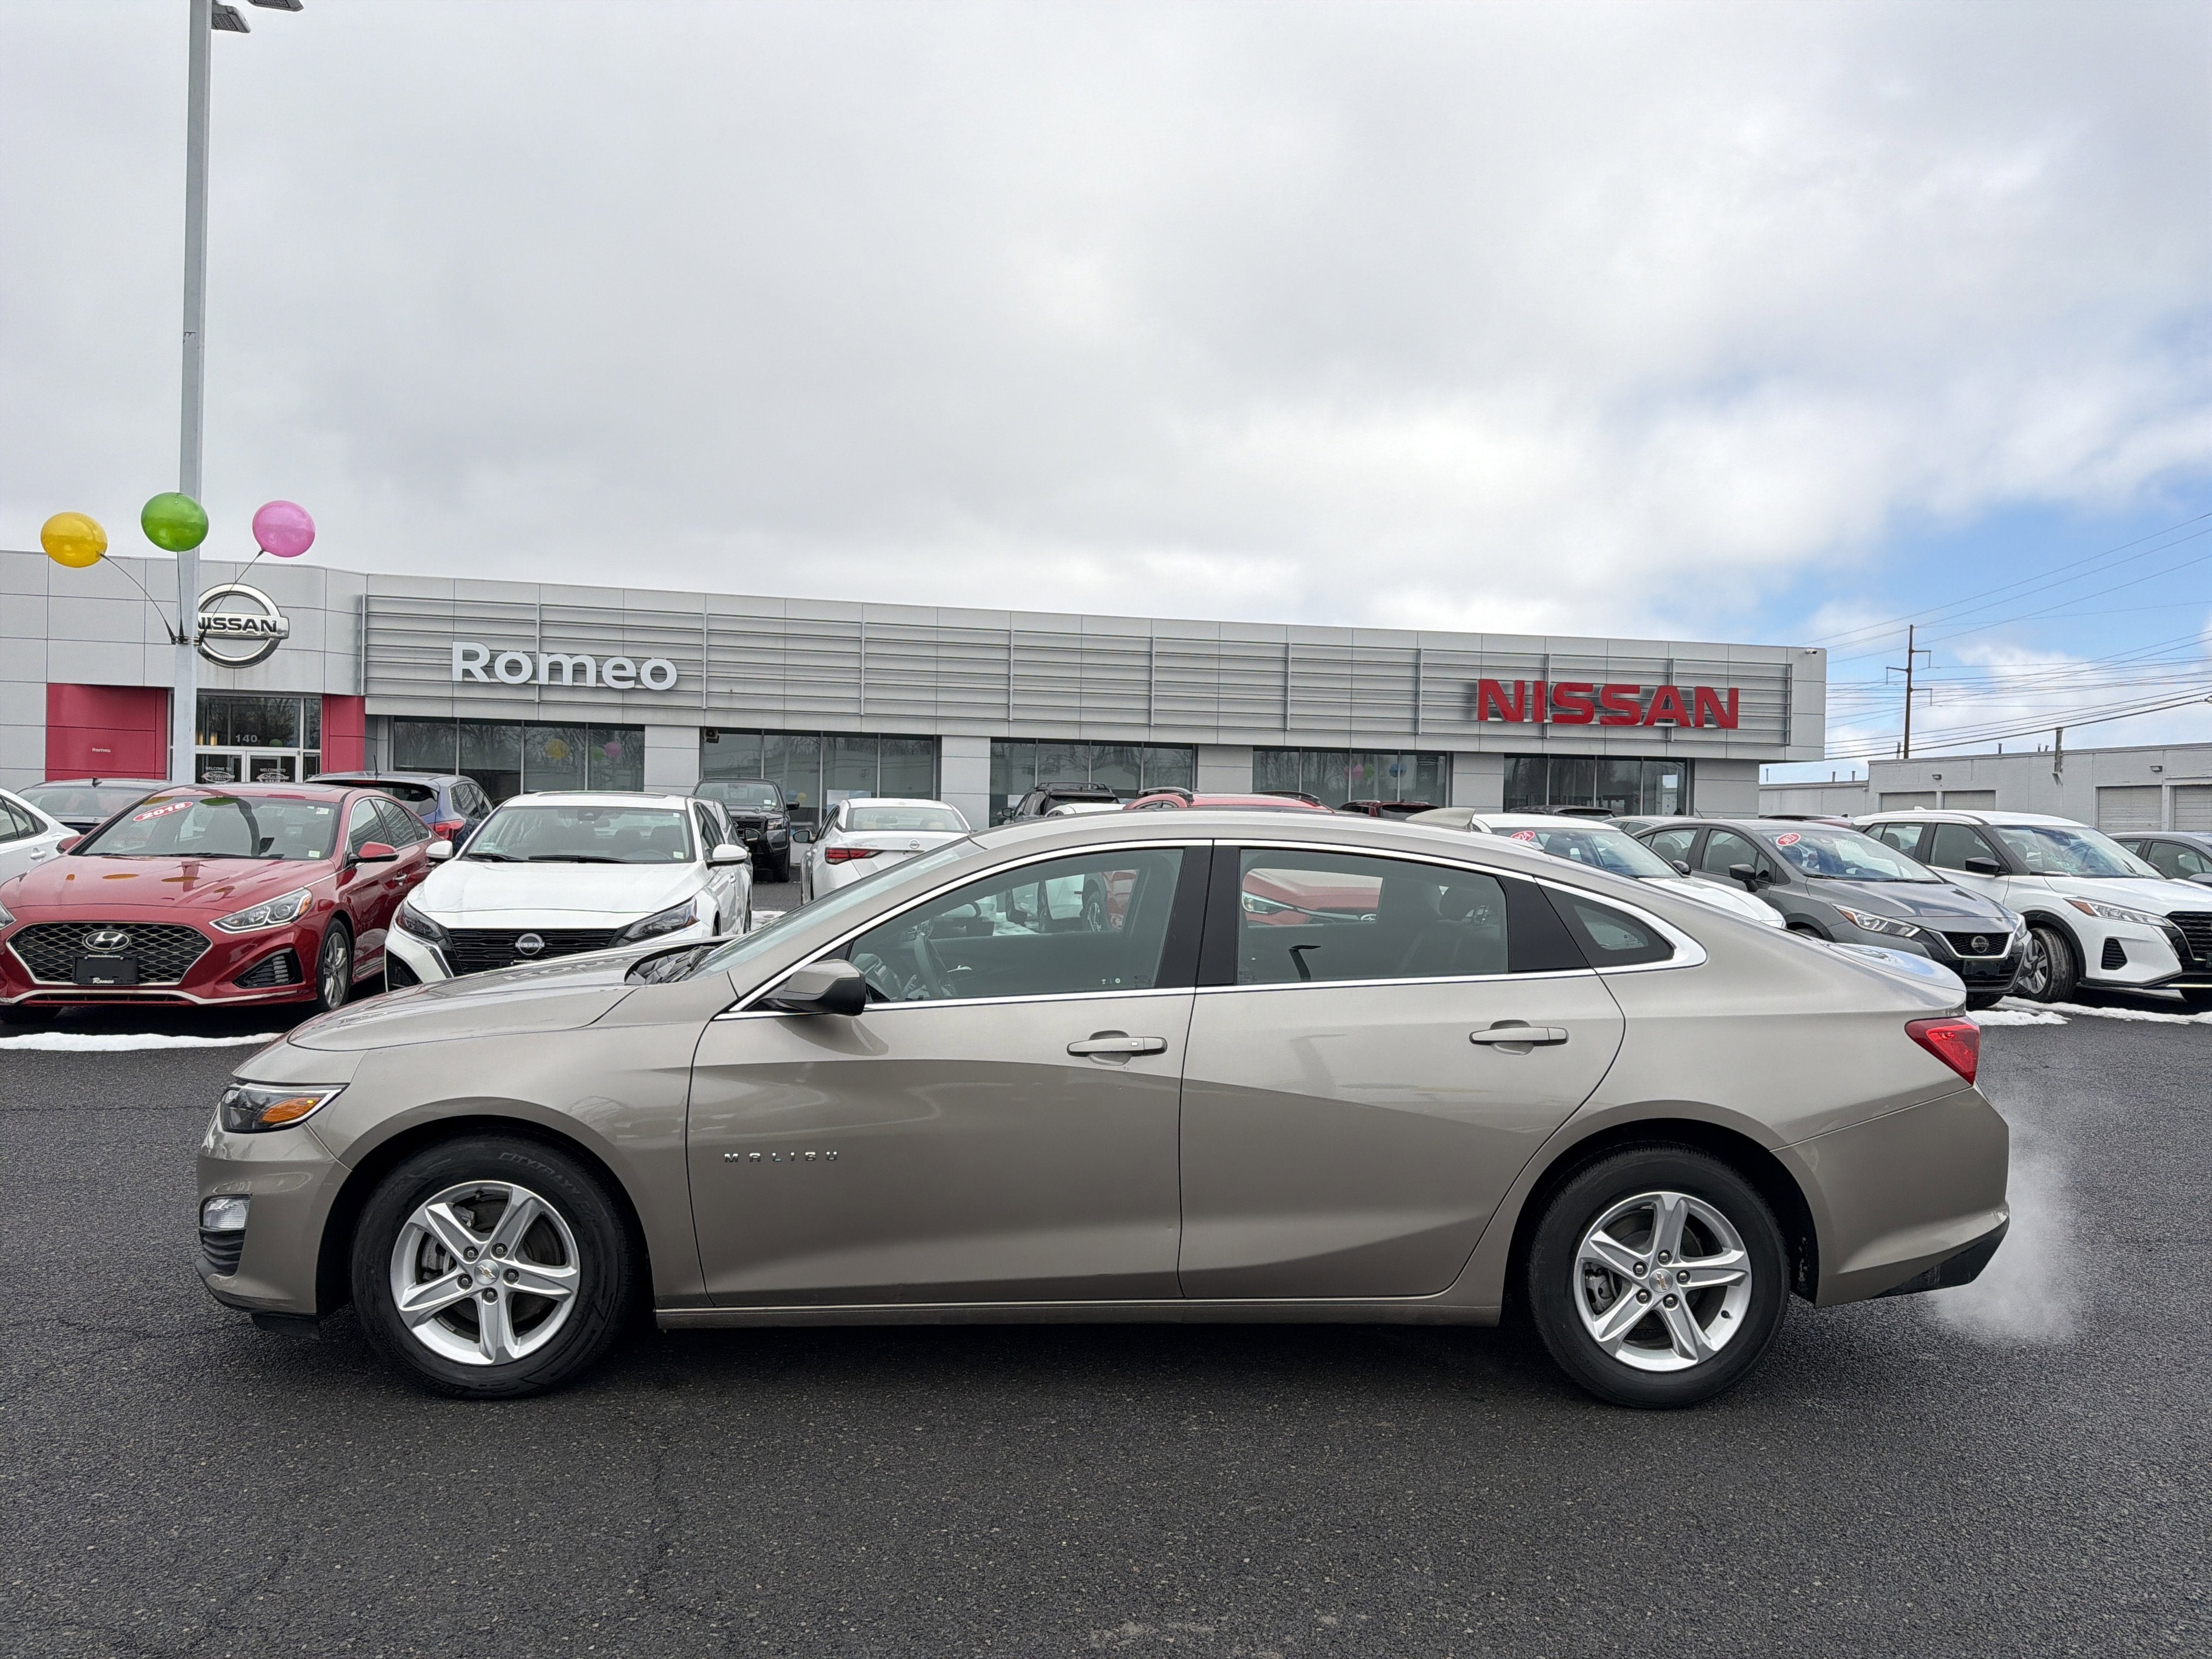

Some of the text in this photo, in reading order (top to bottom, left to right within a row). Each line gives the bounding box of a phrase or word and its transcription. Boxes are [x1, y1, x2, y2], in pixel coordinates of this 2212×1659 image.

[452, 640, 678, 691] Romeo
[1477, 679, 1739, 729] NISSAN
[235, 734, 258, 743] 140
[141, 803, 186, 820] 2018
[1780, 834, 1798, 844] 2021
[724, 1151, 838, 1163] MALIBU
